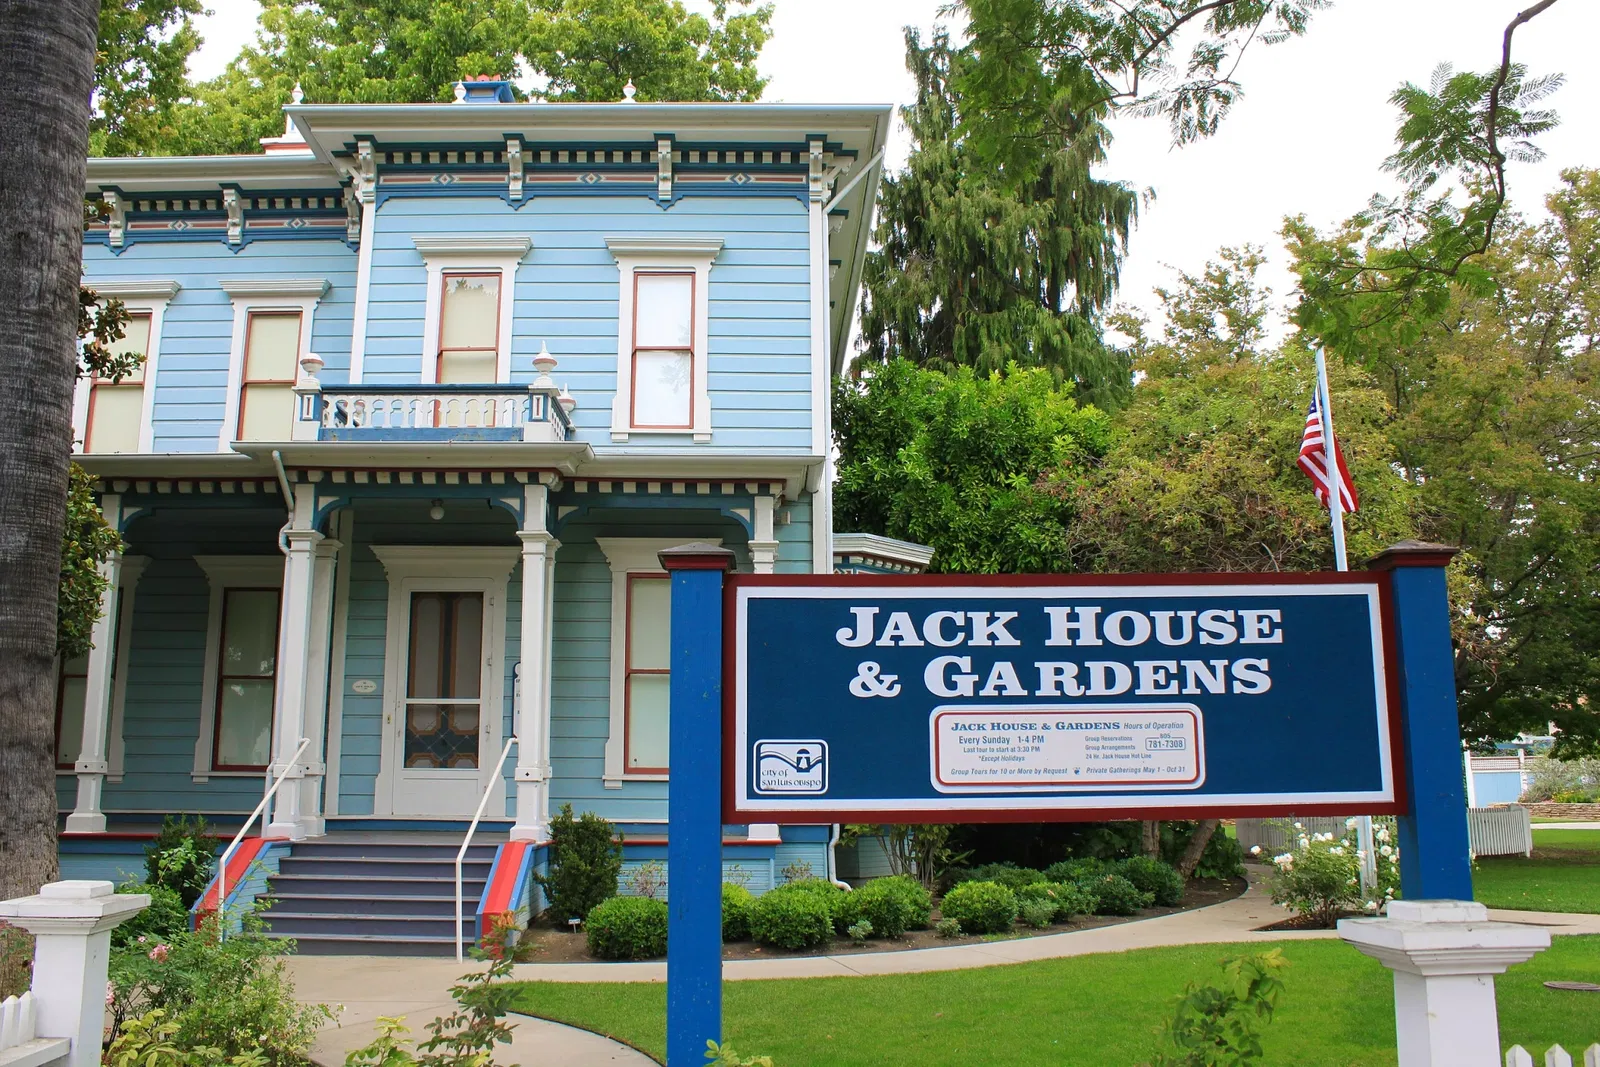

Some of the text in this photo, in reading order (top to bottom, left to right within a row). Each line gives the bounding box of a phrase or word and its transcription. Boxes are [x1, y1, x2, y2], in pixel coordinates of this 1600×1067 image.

[836, 606, 1284, 647] JACK HOUSE
[849, 656, 1272, 697] & GARDENS
[951, 723, 986, 731] JACK
[1056, 722, 1120, 730] GARDENS
[959, 736, 980, 745] Every
[983, 736, 1010, 744] Sunday
